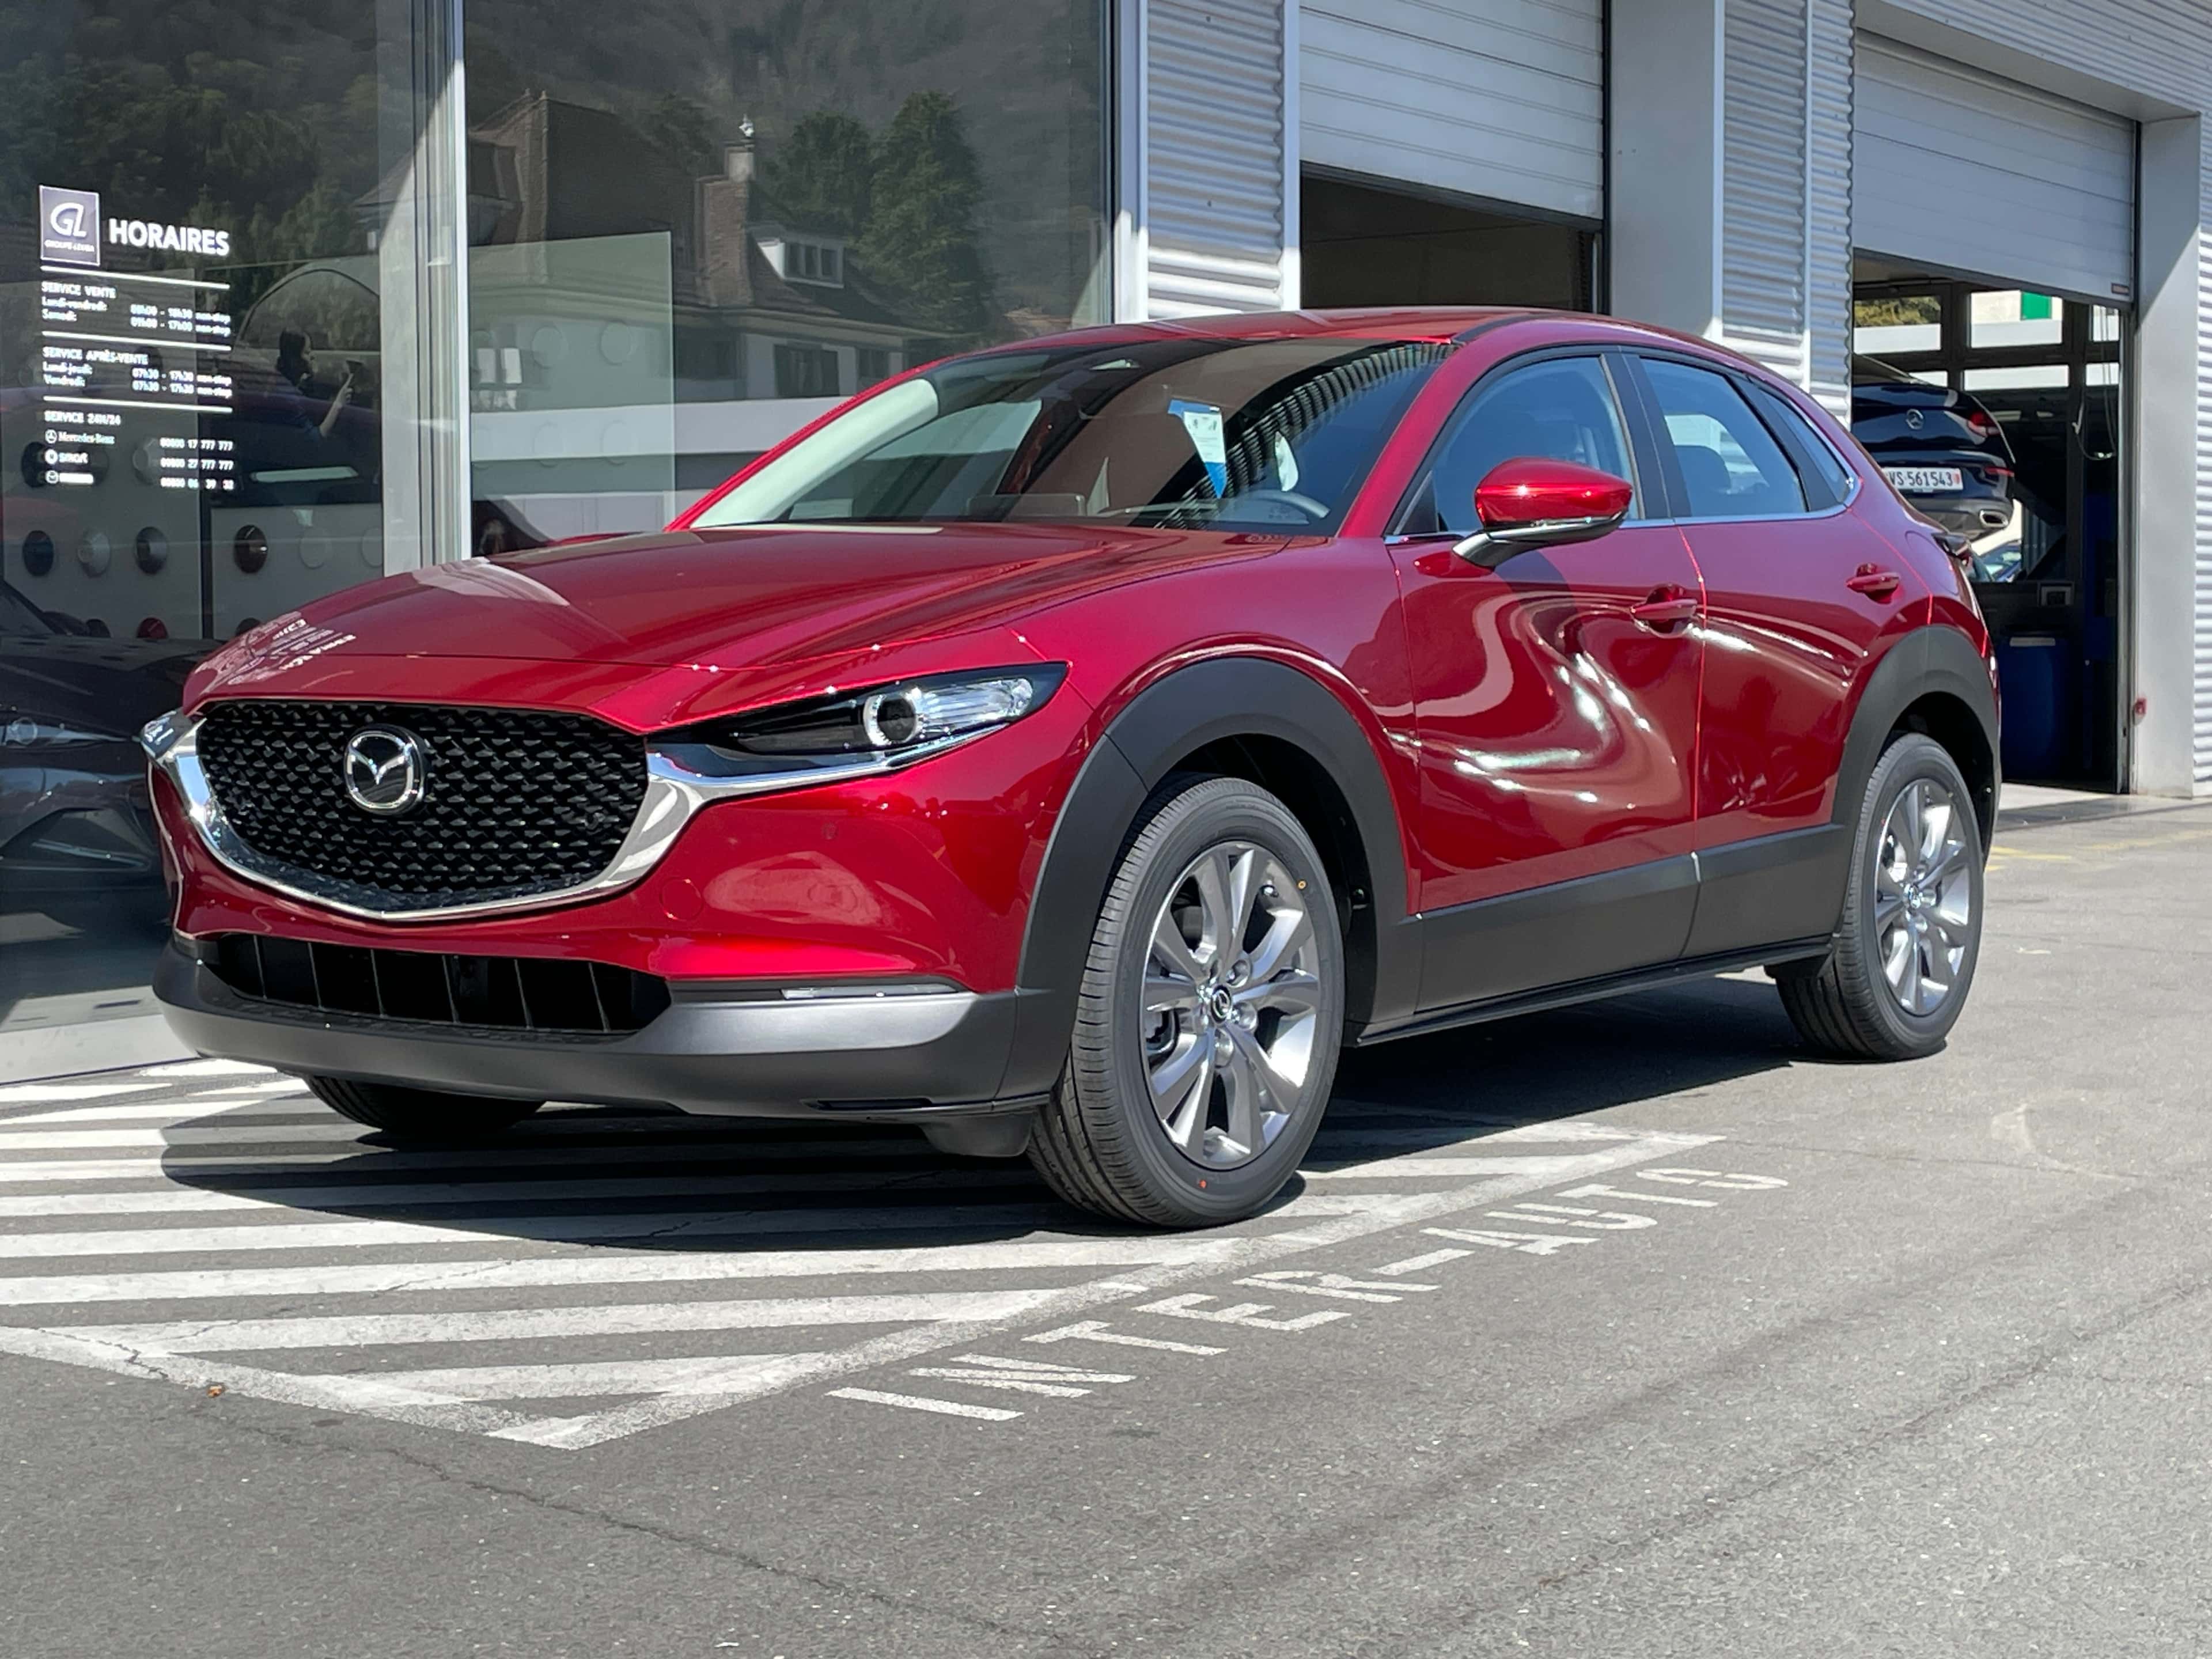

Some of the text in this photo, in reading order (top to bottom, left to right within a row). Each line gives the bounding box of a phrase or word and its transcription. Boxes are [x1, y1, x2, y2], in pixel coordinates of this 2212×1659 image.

[109, 218, 229, 256] HORAIRES
[41, 281, 116, 298] SERVICE VENTE
[43, 347, 82, 360] SERVICE
[44, 411, 84, 424] SERVICE
[1889, 471, 1953, 487] VS 561543
